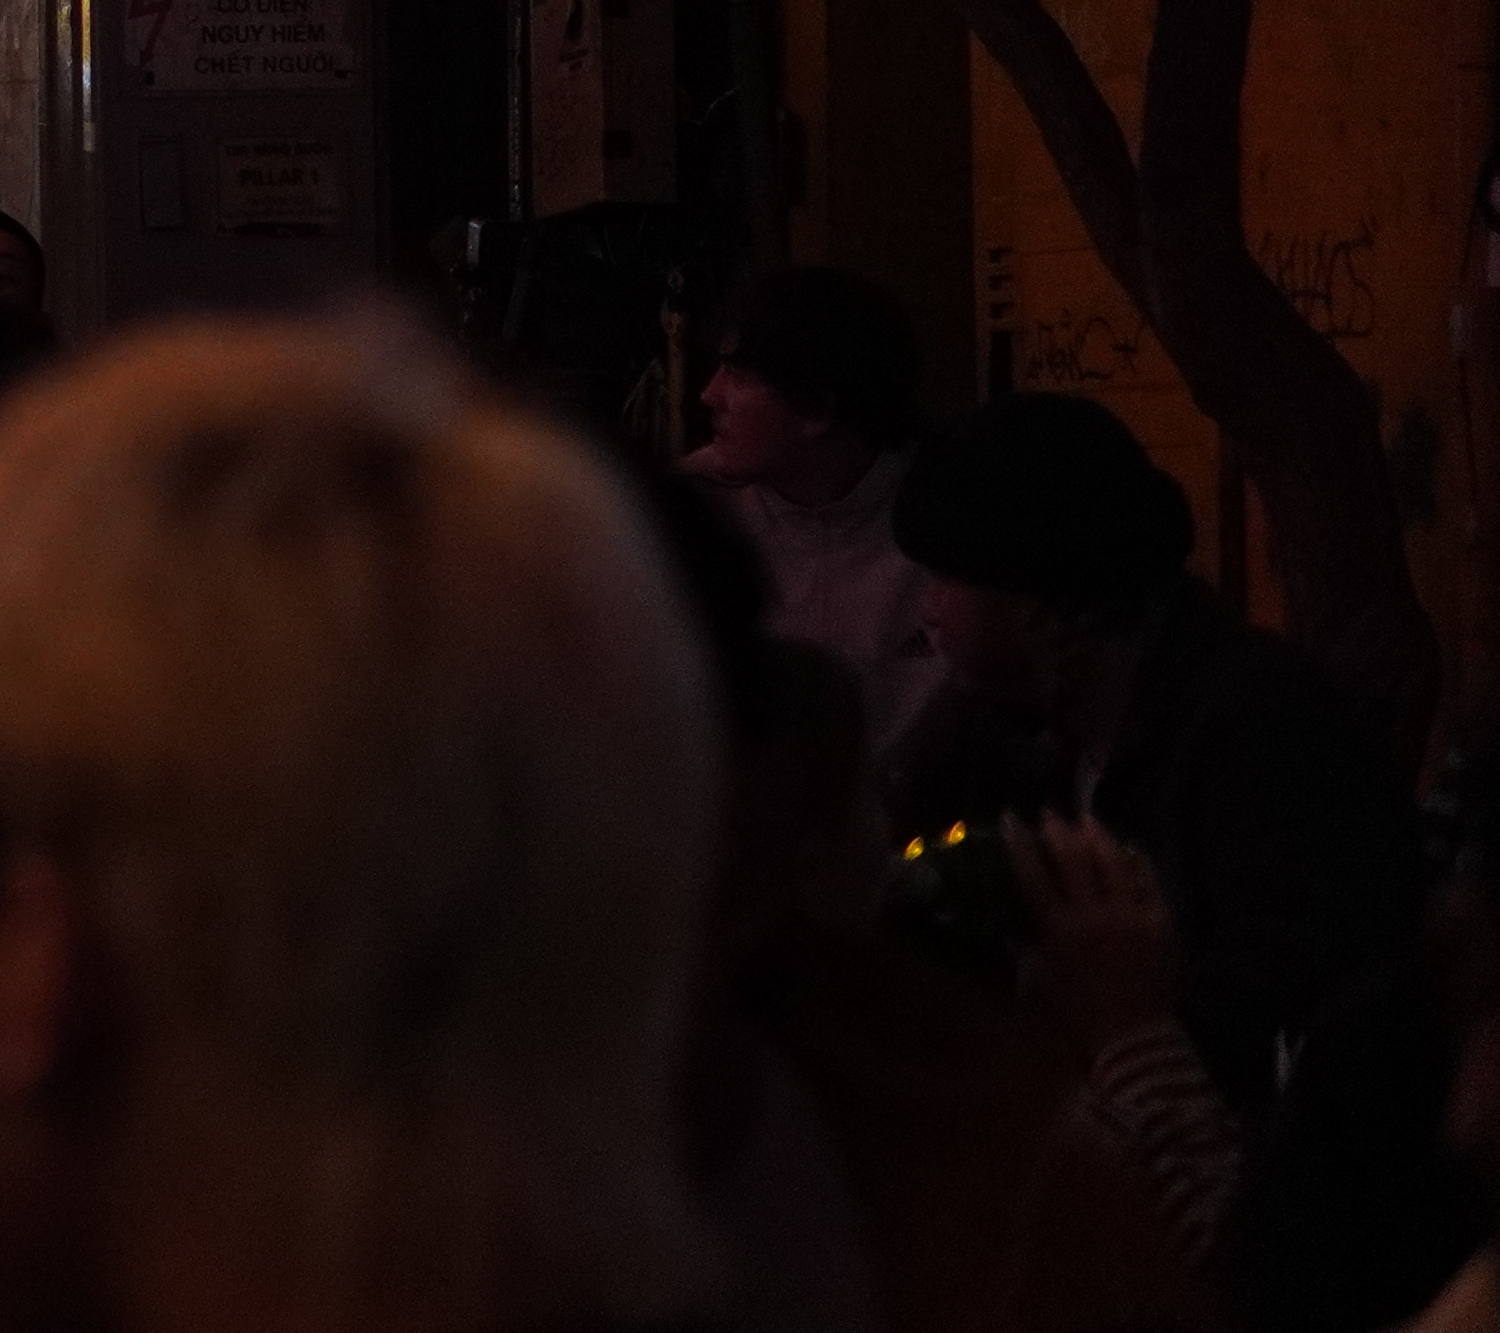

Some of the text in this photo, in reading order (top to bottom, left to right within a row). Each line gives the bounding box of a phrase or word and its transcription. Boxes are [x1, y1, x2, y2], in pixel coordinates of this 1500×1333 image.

[201, 24, 265, 44] NGUY
[194, 49, 256, 75] CHẾT
[239, 167, 304, 186] PILLAR
